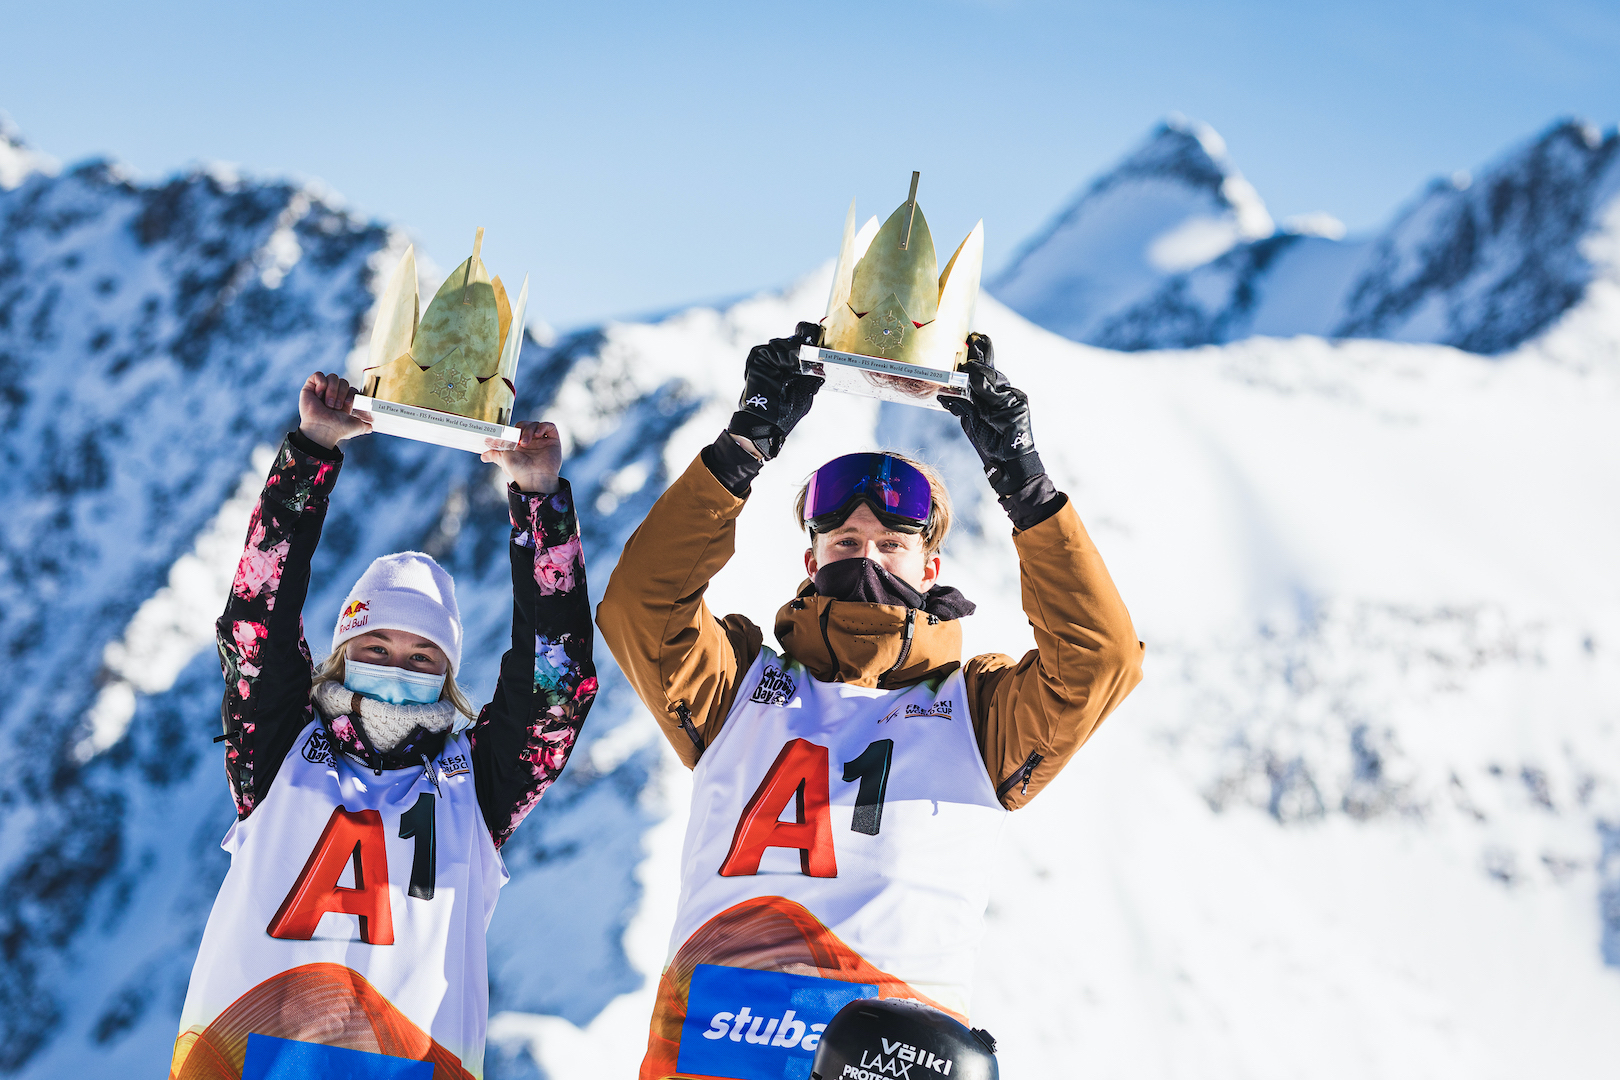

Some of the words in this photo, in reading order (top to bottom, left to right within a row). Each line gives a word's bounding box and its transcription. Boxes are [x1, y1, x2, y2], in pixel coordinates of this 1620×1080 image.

[833, 354, 846, 362] Place
[870, 361, 888, 369] Freeski
[889, 364, 903, 372] World
[903, 366, 913, 374] Cup
[913, 368, 929, 377] Stubai
[929, 371, 943, 379] 2020
[399, 408, 416, 416] Women
[427, 414, 444, 422] Freeski
[445, 417, 459, 425] World
[459, 420, 468, 428] Cup
[468, 422, 483, 431] Stubai
[351, 614, 369, 629] Bull
[936, 707, 953, 715] CUP
[717, 737, 894, 878] A1
[266, 792, 437, 946] A1
[702, 1006, 828, 1051] stuba
[860, 1049, 913, 1080] LAAX
[881, 1037, 953, 1076] Völkl
